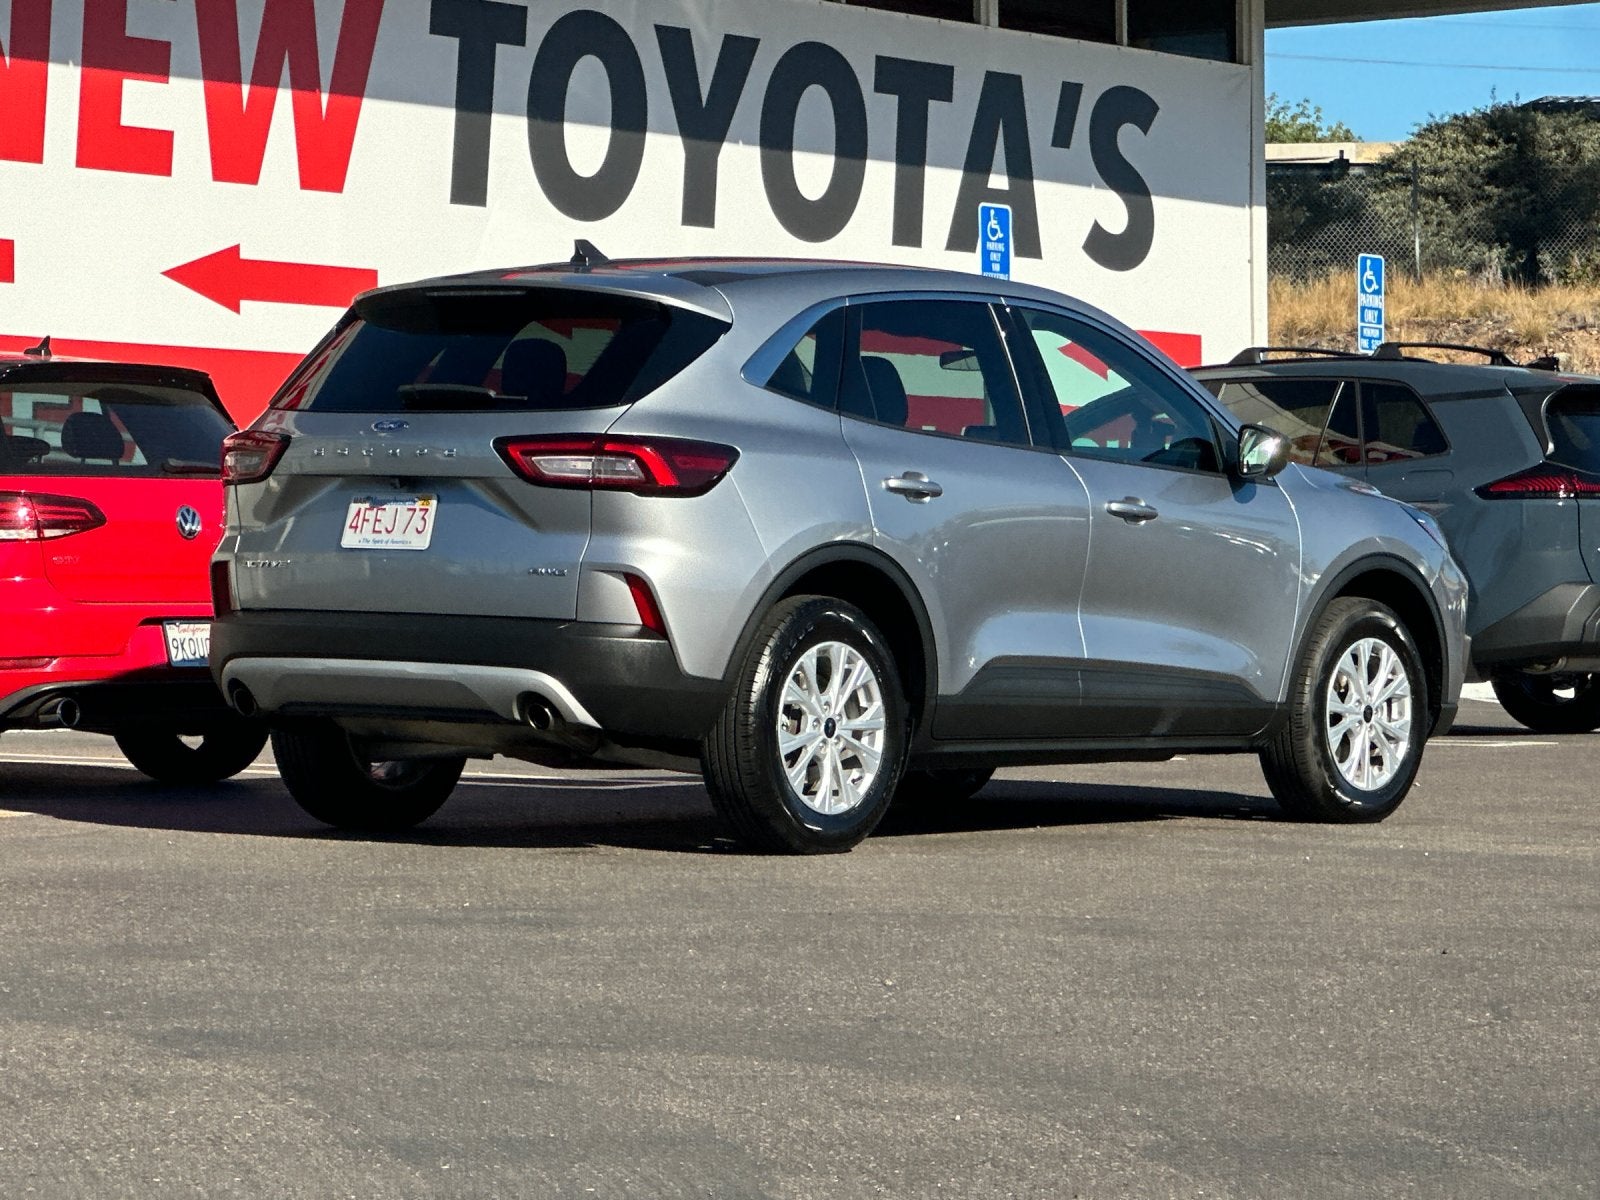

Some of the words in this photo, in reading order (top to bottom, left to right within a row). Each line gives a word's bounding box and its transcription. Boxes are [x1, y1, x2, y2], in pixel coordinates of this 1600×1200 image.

[429, 0, 1160, 272] TOYOTA'S
[986, 241, 1005, 252] PARKING
[989, 252, 1001, 262] ONLY
[1360, 293, 1383, 308] PARKING
[1364, 308, 1379, 323] ONLY
[348, 507, 399, 535] 4FEJ
[402, 507, 430, 535] 73
